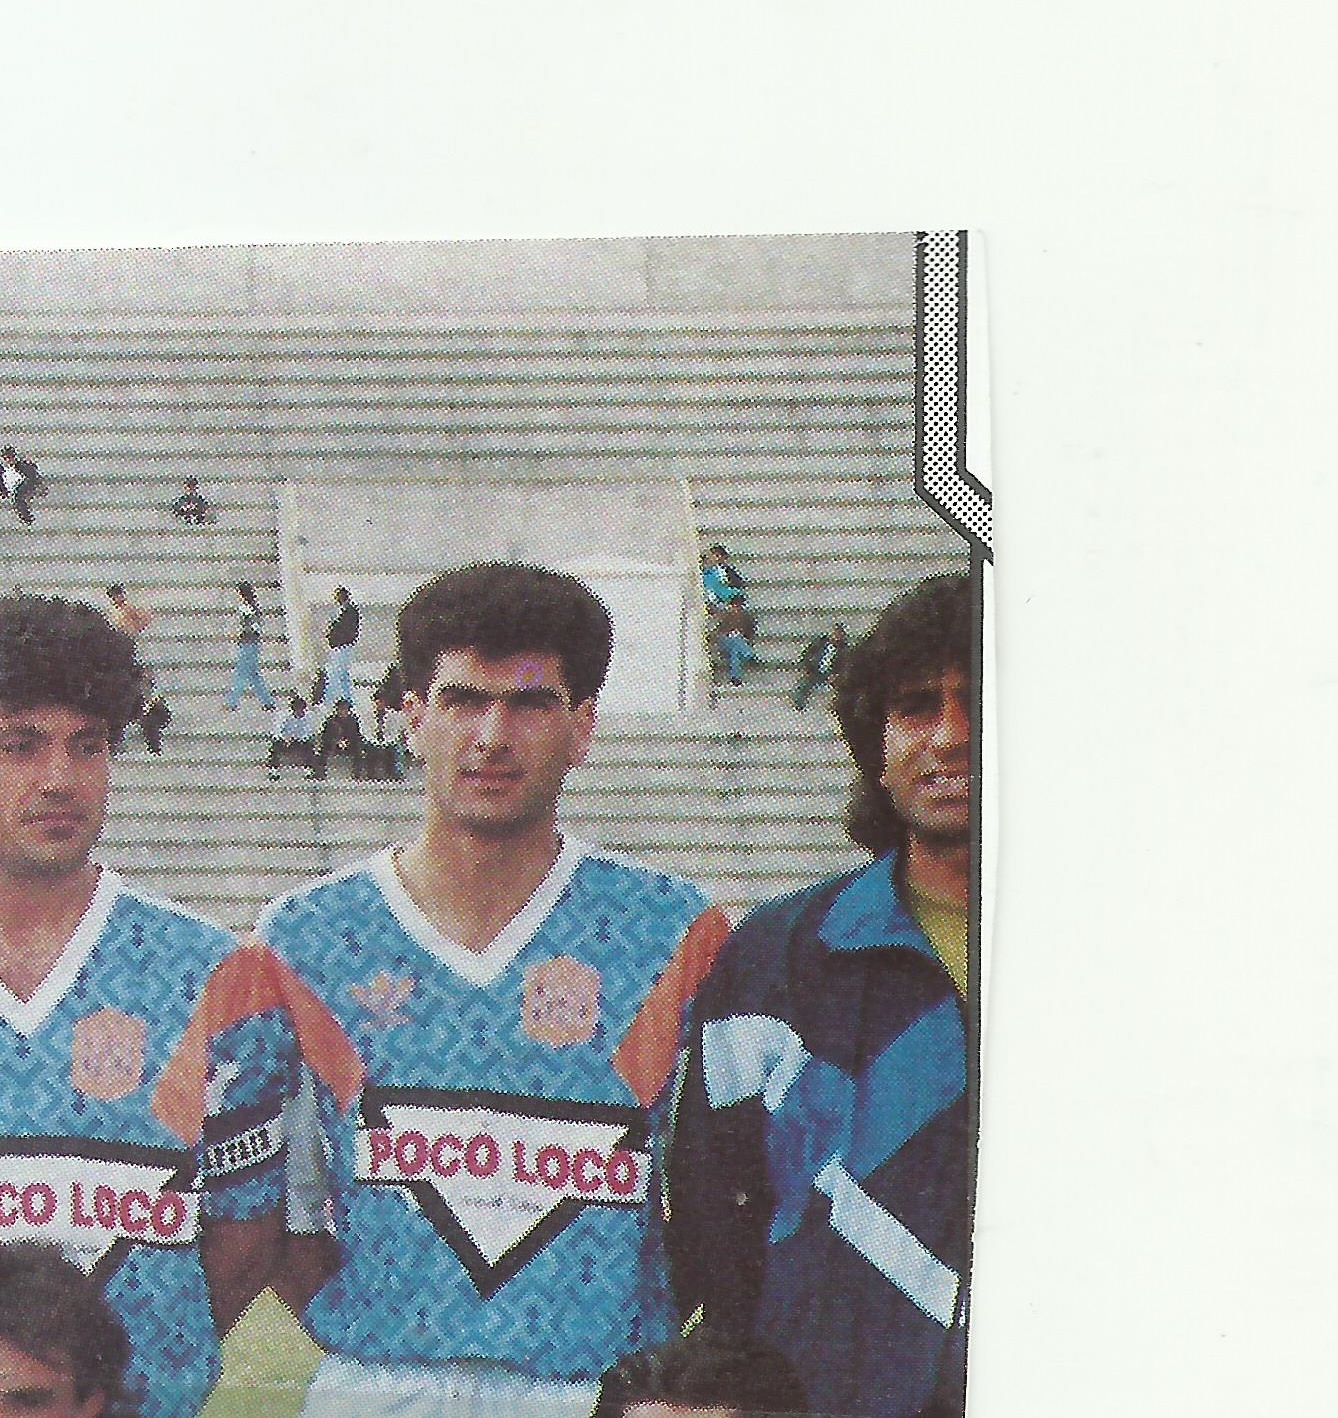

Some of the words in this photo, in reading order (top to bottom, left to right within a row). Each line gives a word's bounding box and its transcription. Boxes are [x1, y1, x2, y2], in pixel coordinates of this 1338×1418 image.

[369, 1129, 502, 1179] POCO
[512, 1141, 640, 1197] LOCO
[71, 1181, 188, 1238] LOCO
